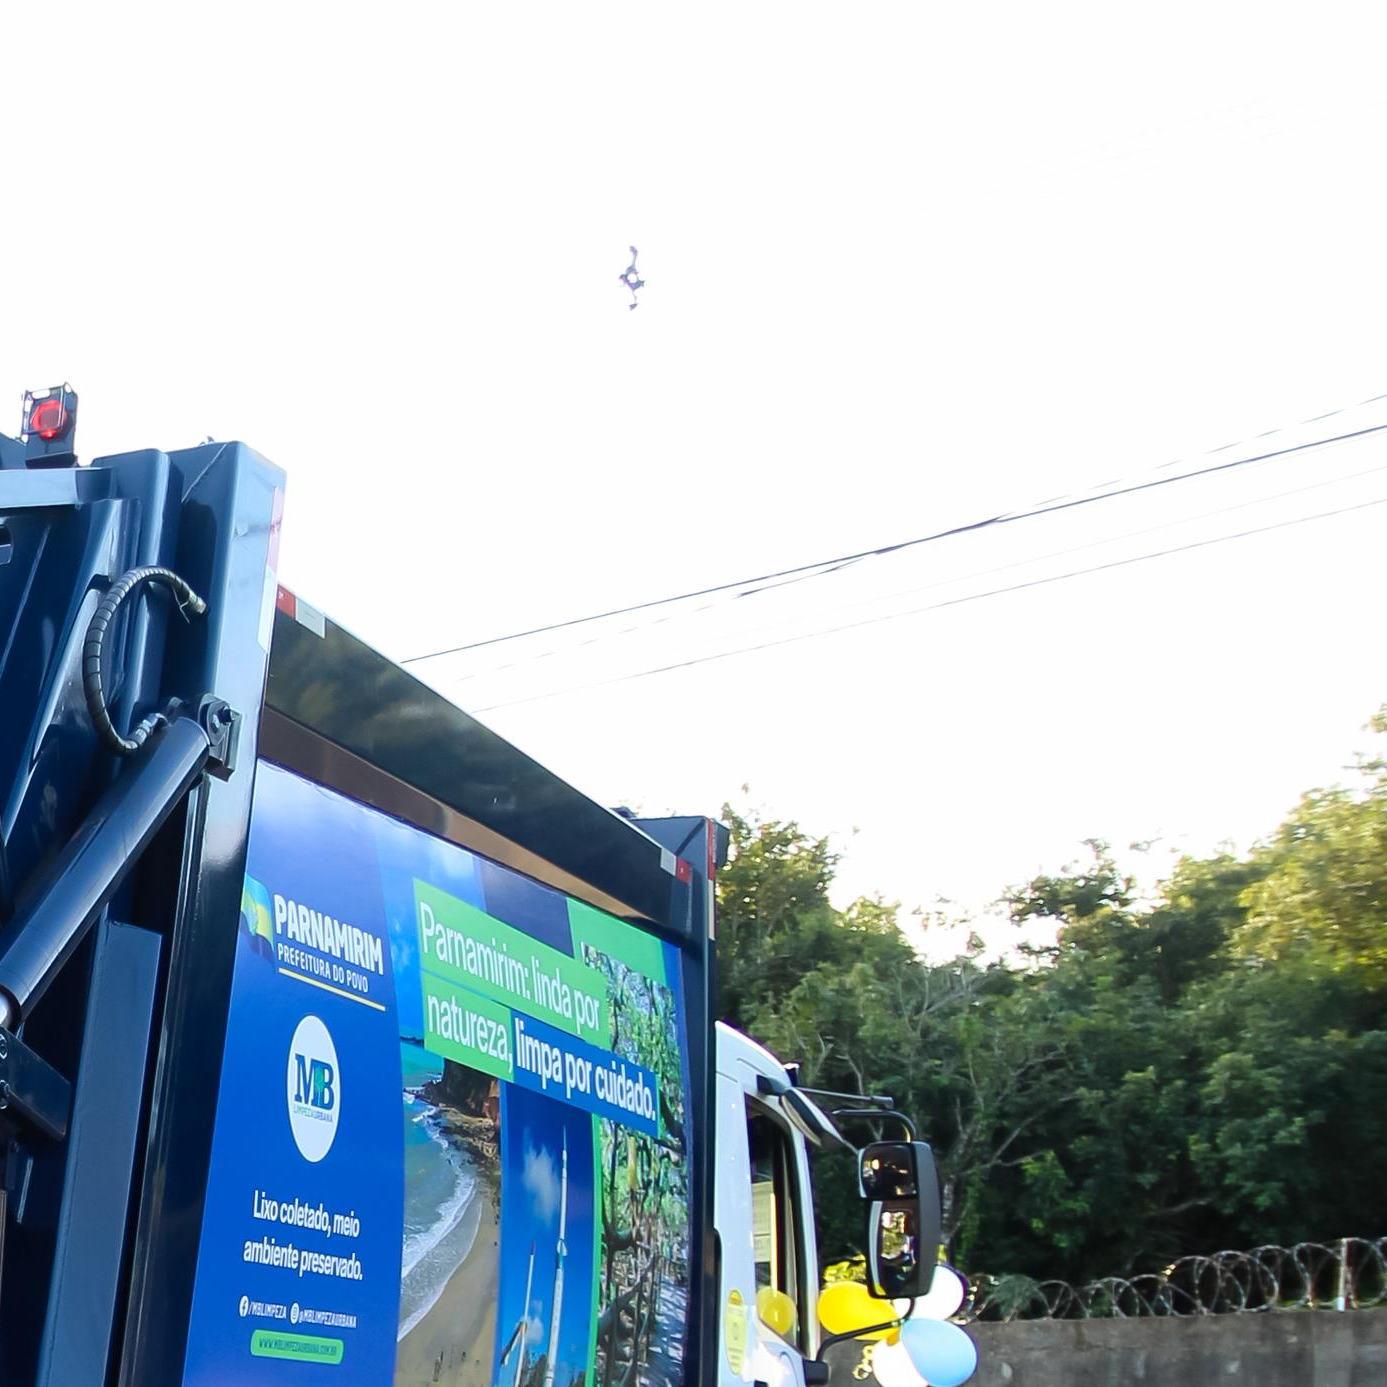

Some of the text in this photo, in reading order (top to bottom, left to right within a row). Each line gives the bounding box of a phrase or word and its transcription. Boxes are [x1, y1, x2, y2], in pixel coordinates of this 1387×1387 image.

[274, 894, 384, 975] PARNAMIRIM
[277, 943, 369, 993] PREFEITURA DO POVO
[420, 901, 600, 1035] Parnamirim: linda por
[294, 1052, 334, 1111] MB
[427, 995, 656, 1121] natureza, limpa por cuidado.
[253, 1190, 360, 1238] Lixo coletado, meio
[243, 1236, 363, 1281] ambiente preservado.
